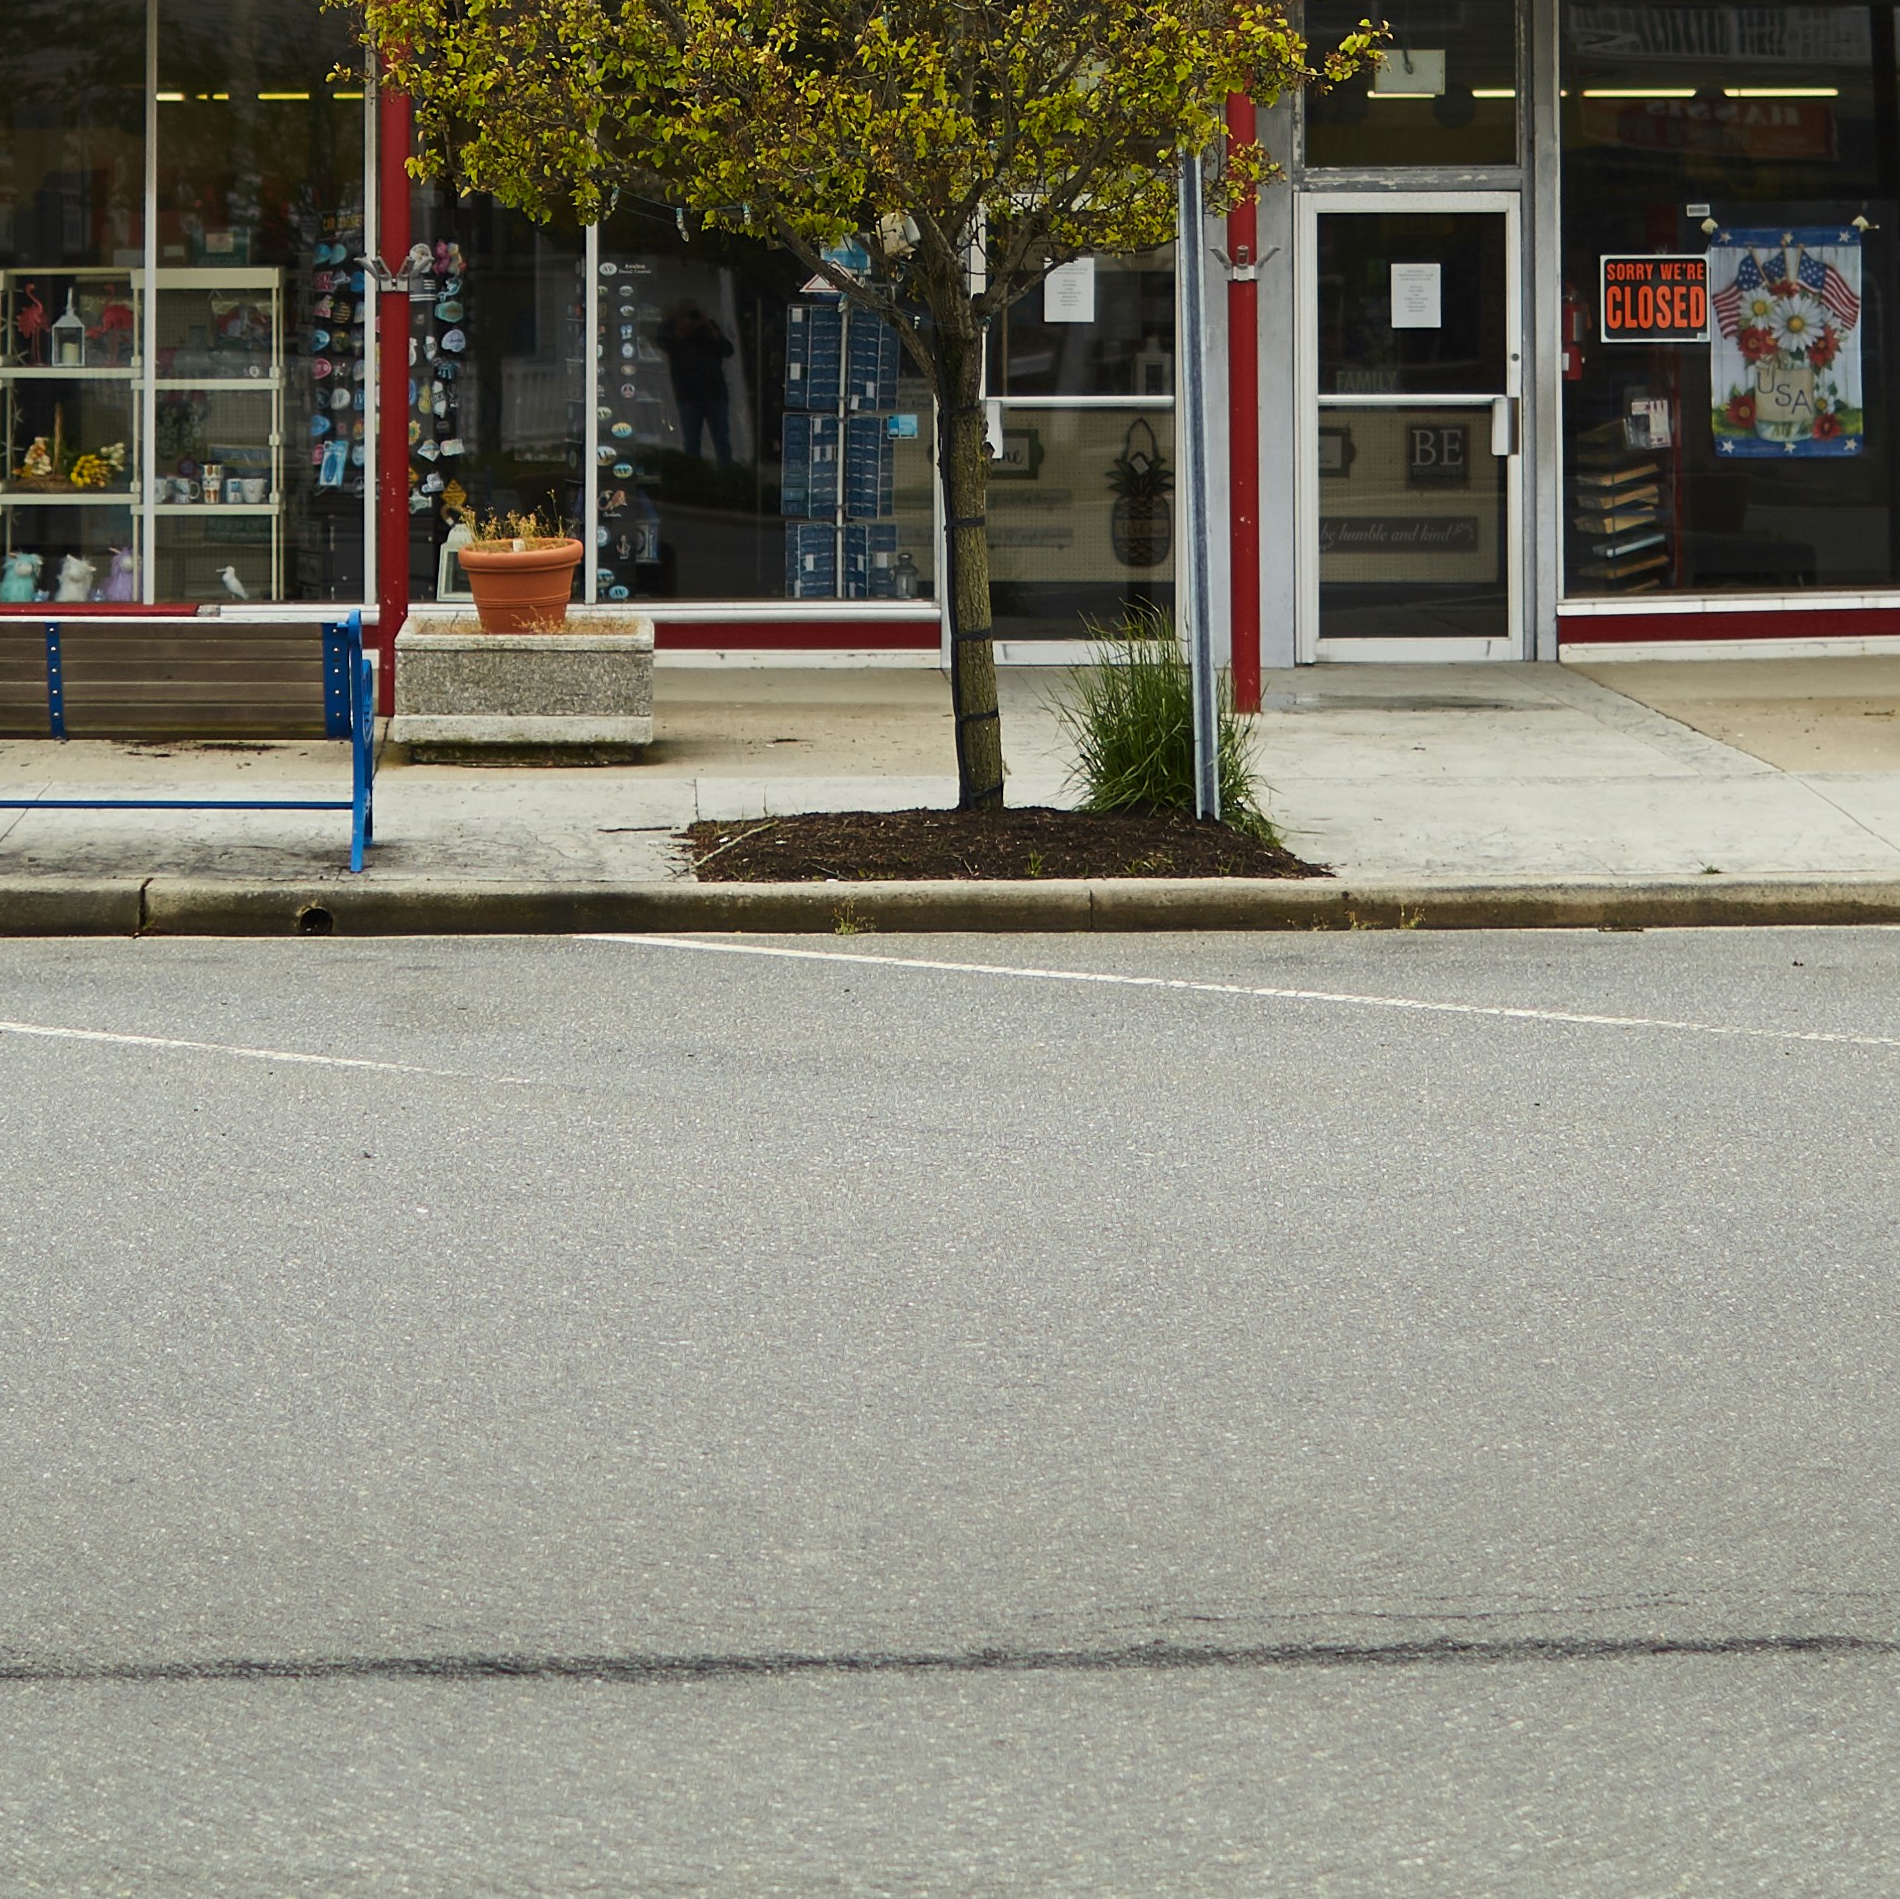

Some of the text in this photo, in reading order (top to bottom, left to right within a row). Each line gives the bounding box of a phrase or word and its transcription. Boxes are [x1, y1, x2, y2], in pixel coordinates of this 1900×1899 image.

[1606, 263, 1705, 281] SORRY WE'RE
[1606, 285, 1706, 329] CLOSED
[1335, 370, 1398, 391] FAMILY
[1757, 371, 1812, 415] USA
[1412, 428, 1464, 466] BE
[1339, 522, 1389, 542] humble
[1390, 524, 1416, 542] and
[1419, 523, 1455, 542] kind
